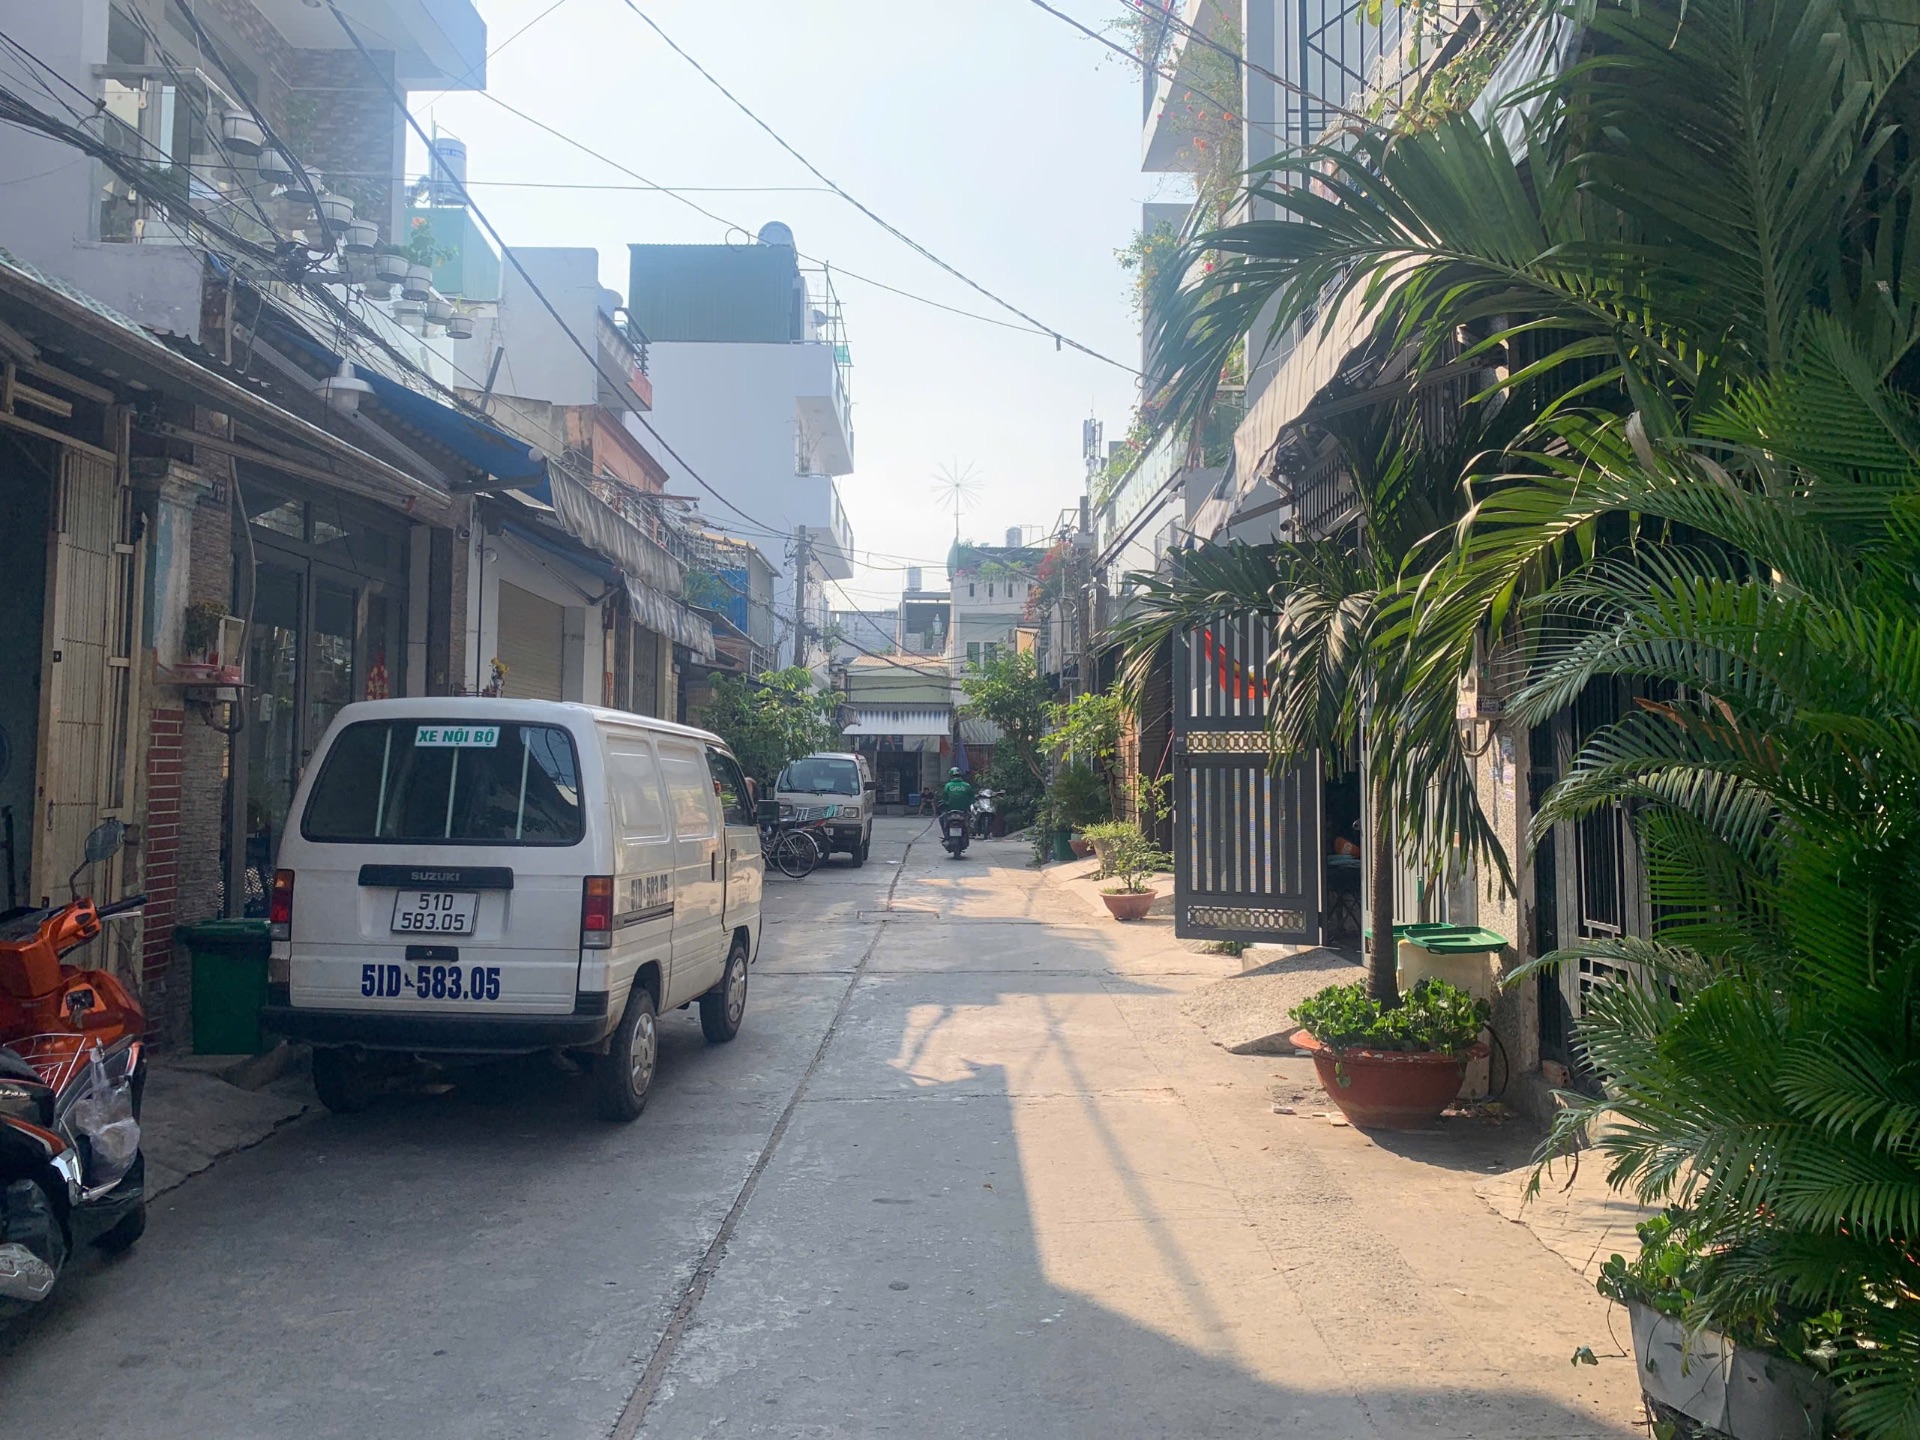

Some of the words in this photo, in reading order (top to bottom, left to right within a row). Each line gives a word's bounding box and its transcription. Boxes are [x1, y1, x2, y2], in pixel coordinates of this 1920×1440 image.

[418, 730, 438, 743] XE
[442, 728, 470, 746] NỘI
[473, 728, 495, 746] BỘ
[411, 871, 460, 882] SUZUKI
[418, 893, 454, 911] 51D
[401, 912, 465, 931] 583.05
[361, 964, 401, 997] 51D
[416, 965, 500, 1000] 583.05
